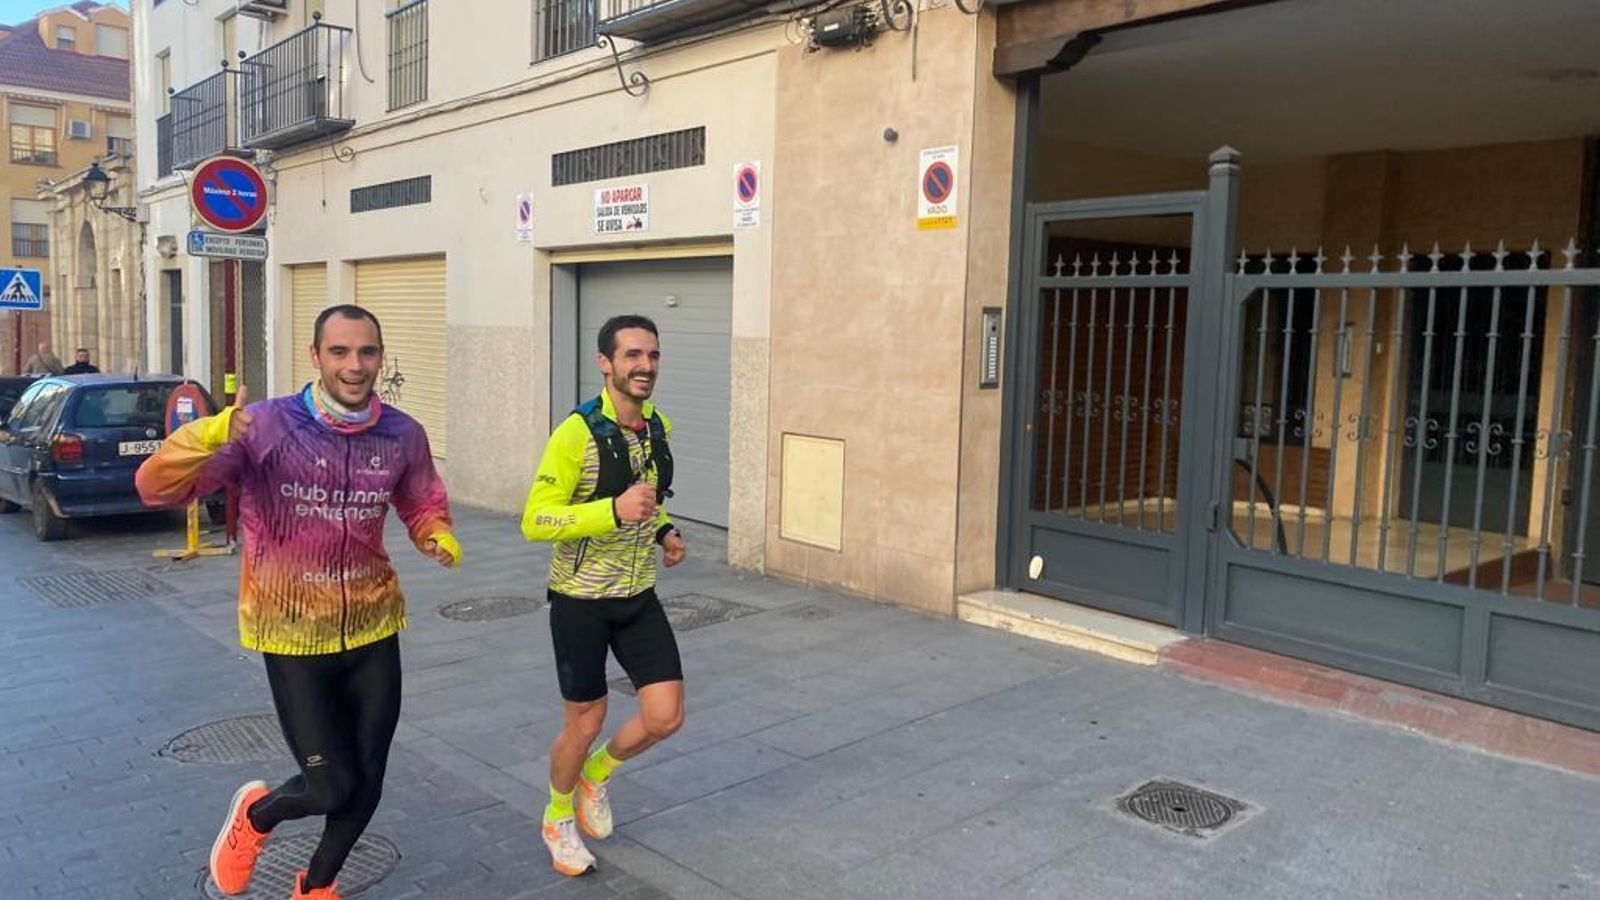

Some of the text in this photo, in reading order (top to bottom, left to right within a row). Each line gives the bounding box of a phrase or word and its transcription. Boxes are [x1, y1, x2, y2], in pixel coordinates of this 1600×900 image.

[601, 187, 643, 204] NO APARCAR
[613, 205, 620, 216] DE
[597, 219, 622, 232] SE AVISA
[280, 481, 391, 503] club runnin
